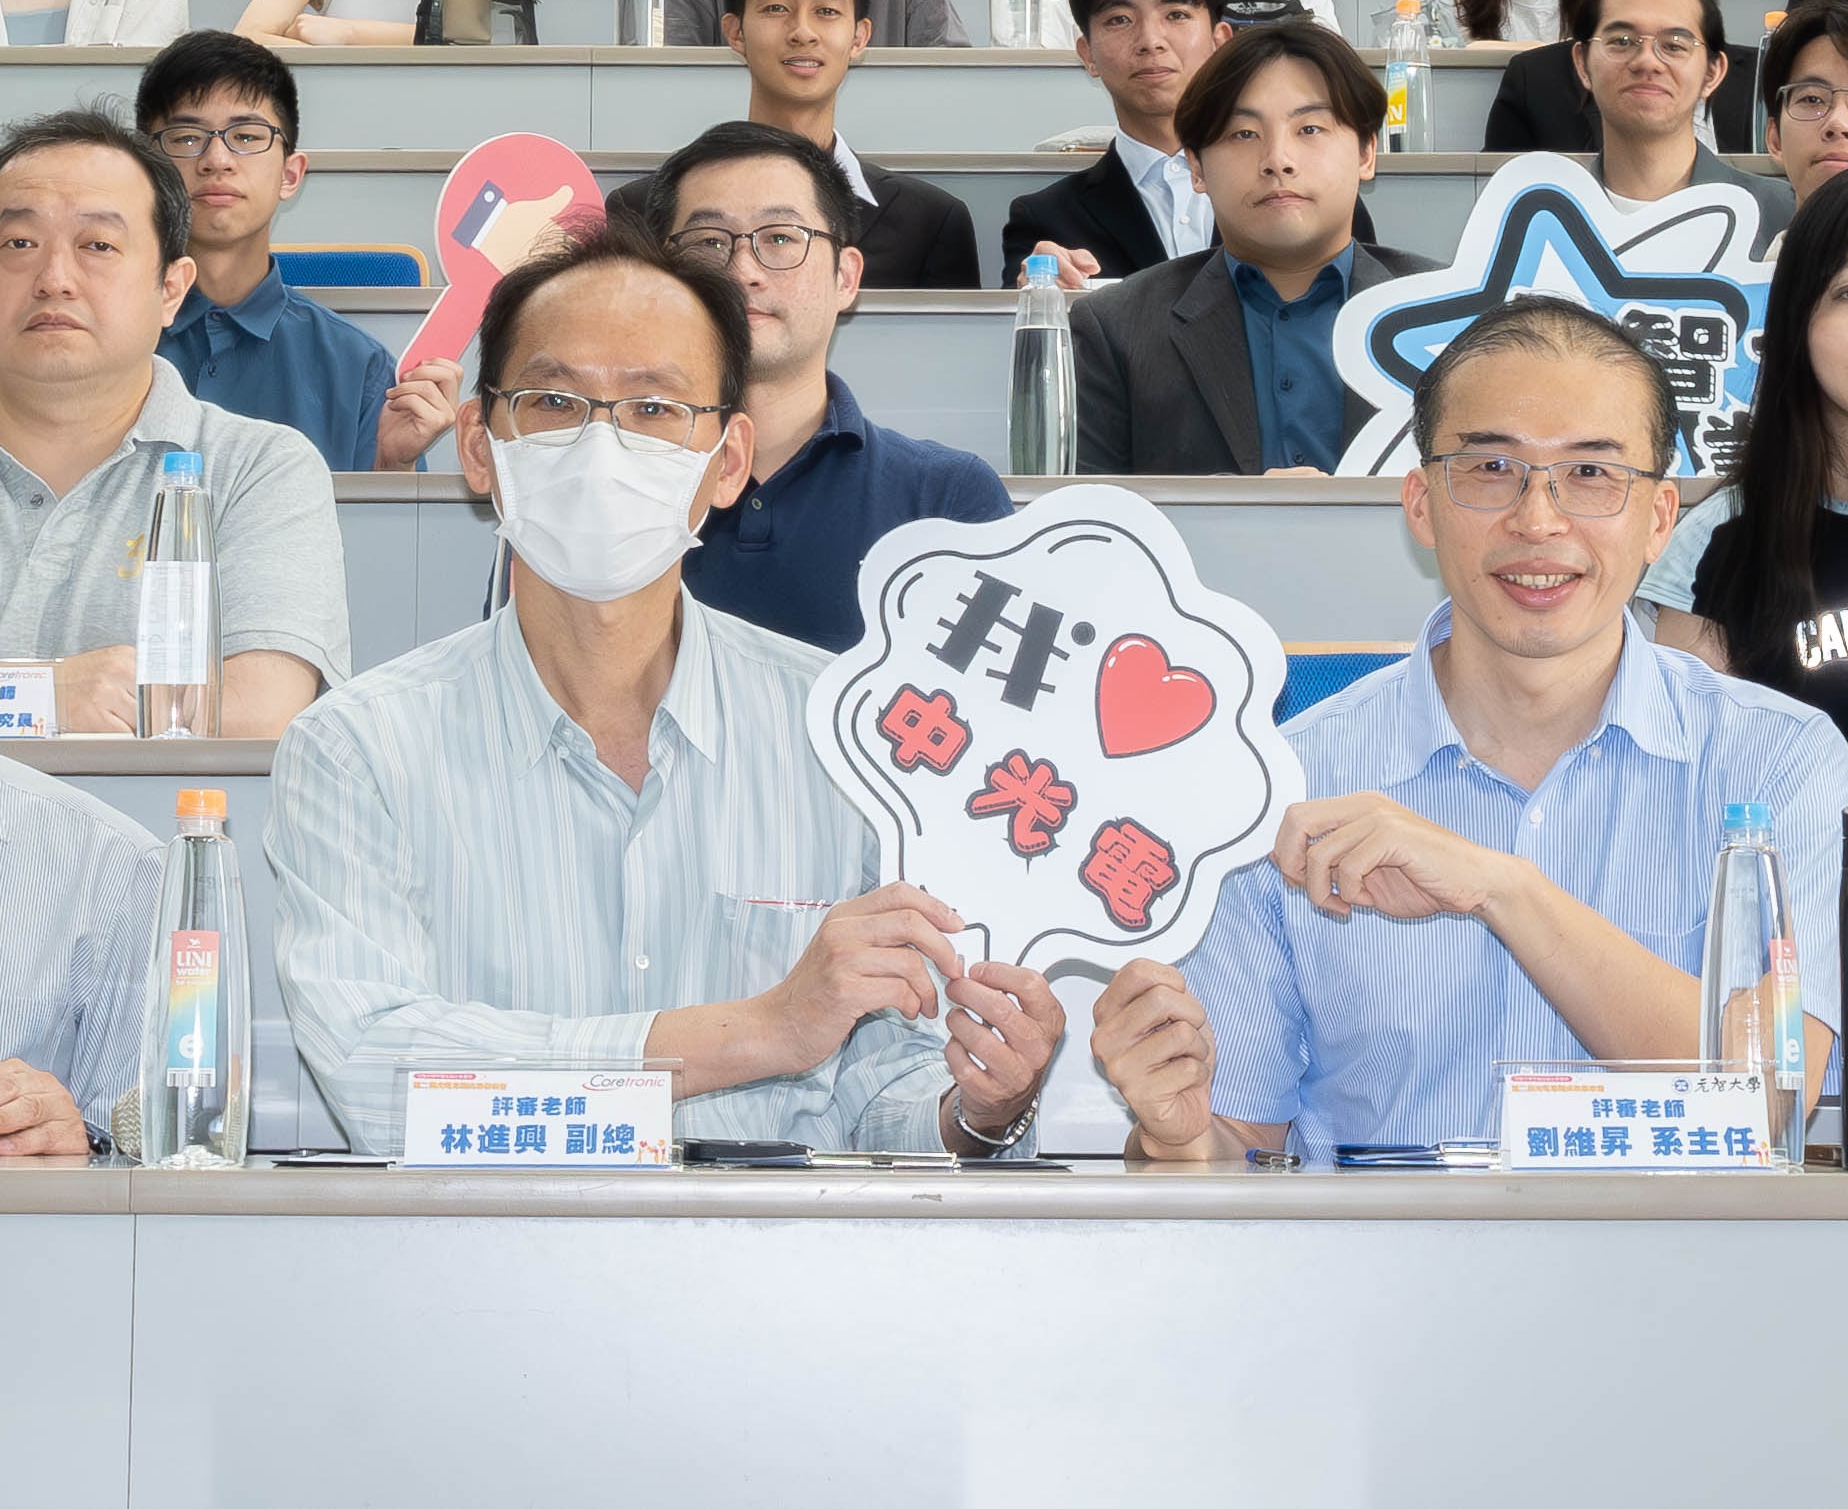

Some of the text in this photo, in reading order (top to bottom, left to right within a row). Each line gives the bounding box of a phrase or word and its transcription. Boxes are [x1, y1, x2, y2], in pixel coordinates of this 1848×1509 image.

[589, 1074, 666, 1090] Coretronic
[1693, 1076, 1762, 1094] 元智大學
[491, 1096, 588, 1117] 評審老師
[1591, 1098, 1687, 1119] 評審老師
[440, 1123, 637, 1155] 林進興 副總
[1526, 1126, 1757, 1158] 劉維昇 系主任
